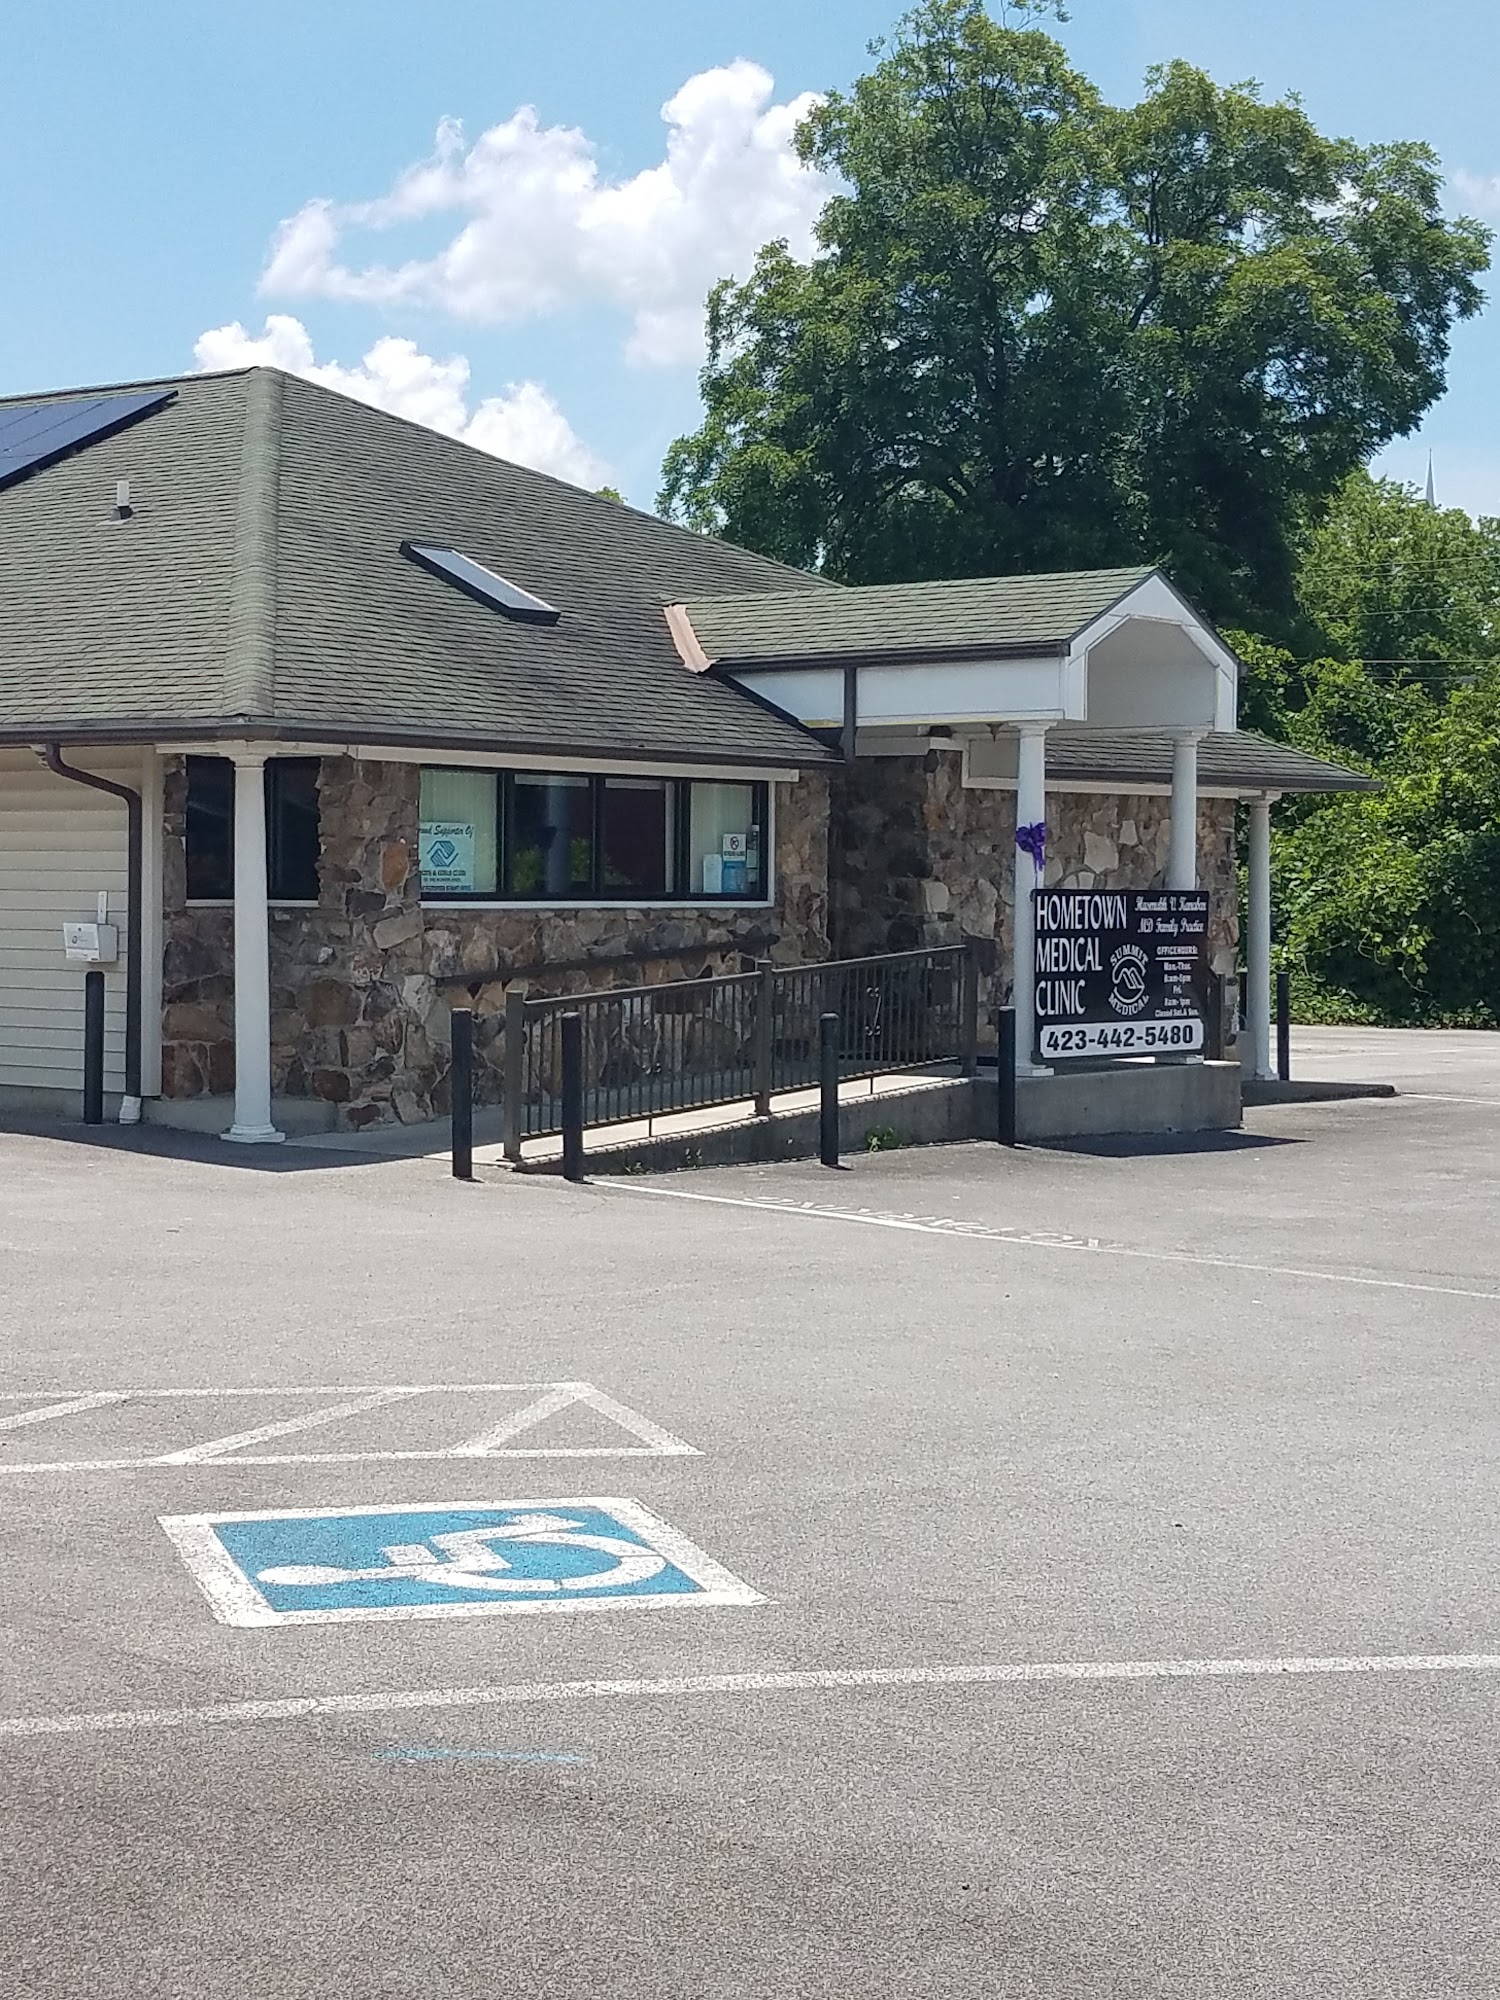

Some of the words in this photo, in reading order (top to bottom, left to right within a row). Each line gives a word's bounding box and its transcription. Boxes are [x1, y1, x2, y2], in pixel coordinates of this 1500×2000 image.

[433, 825, 464, 838] Supporter
[1036, 894, 1127, 931] HOMETOWN
[1137, 917, 1154, 933] MD
[1155, 917, 1179, 938] Family
[1179, 917, 1205, 933] Practice
[1036, 936, 1103, 973] MEDICAL
[1110, 943, 1150, 967] SUMMIT
[1036, 979, 1086, 1017] CLINIC
[1107, 994, 1150, 1016] MEDICAL
[1046, 1025, 1194, 1052] 423-442-5480
